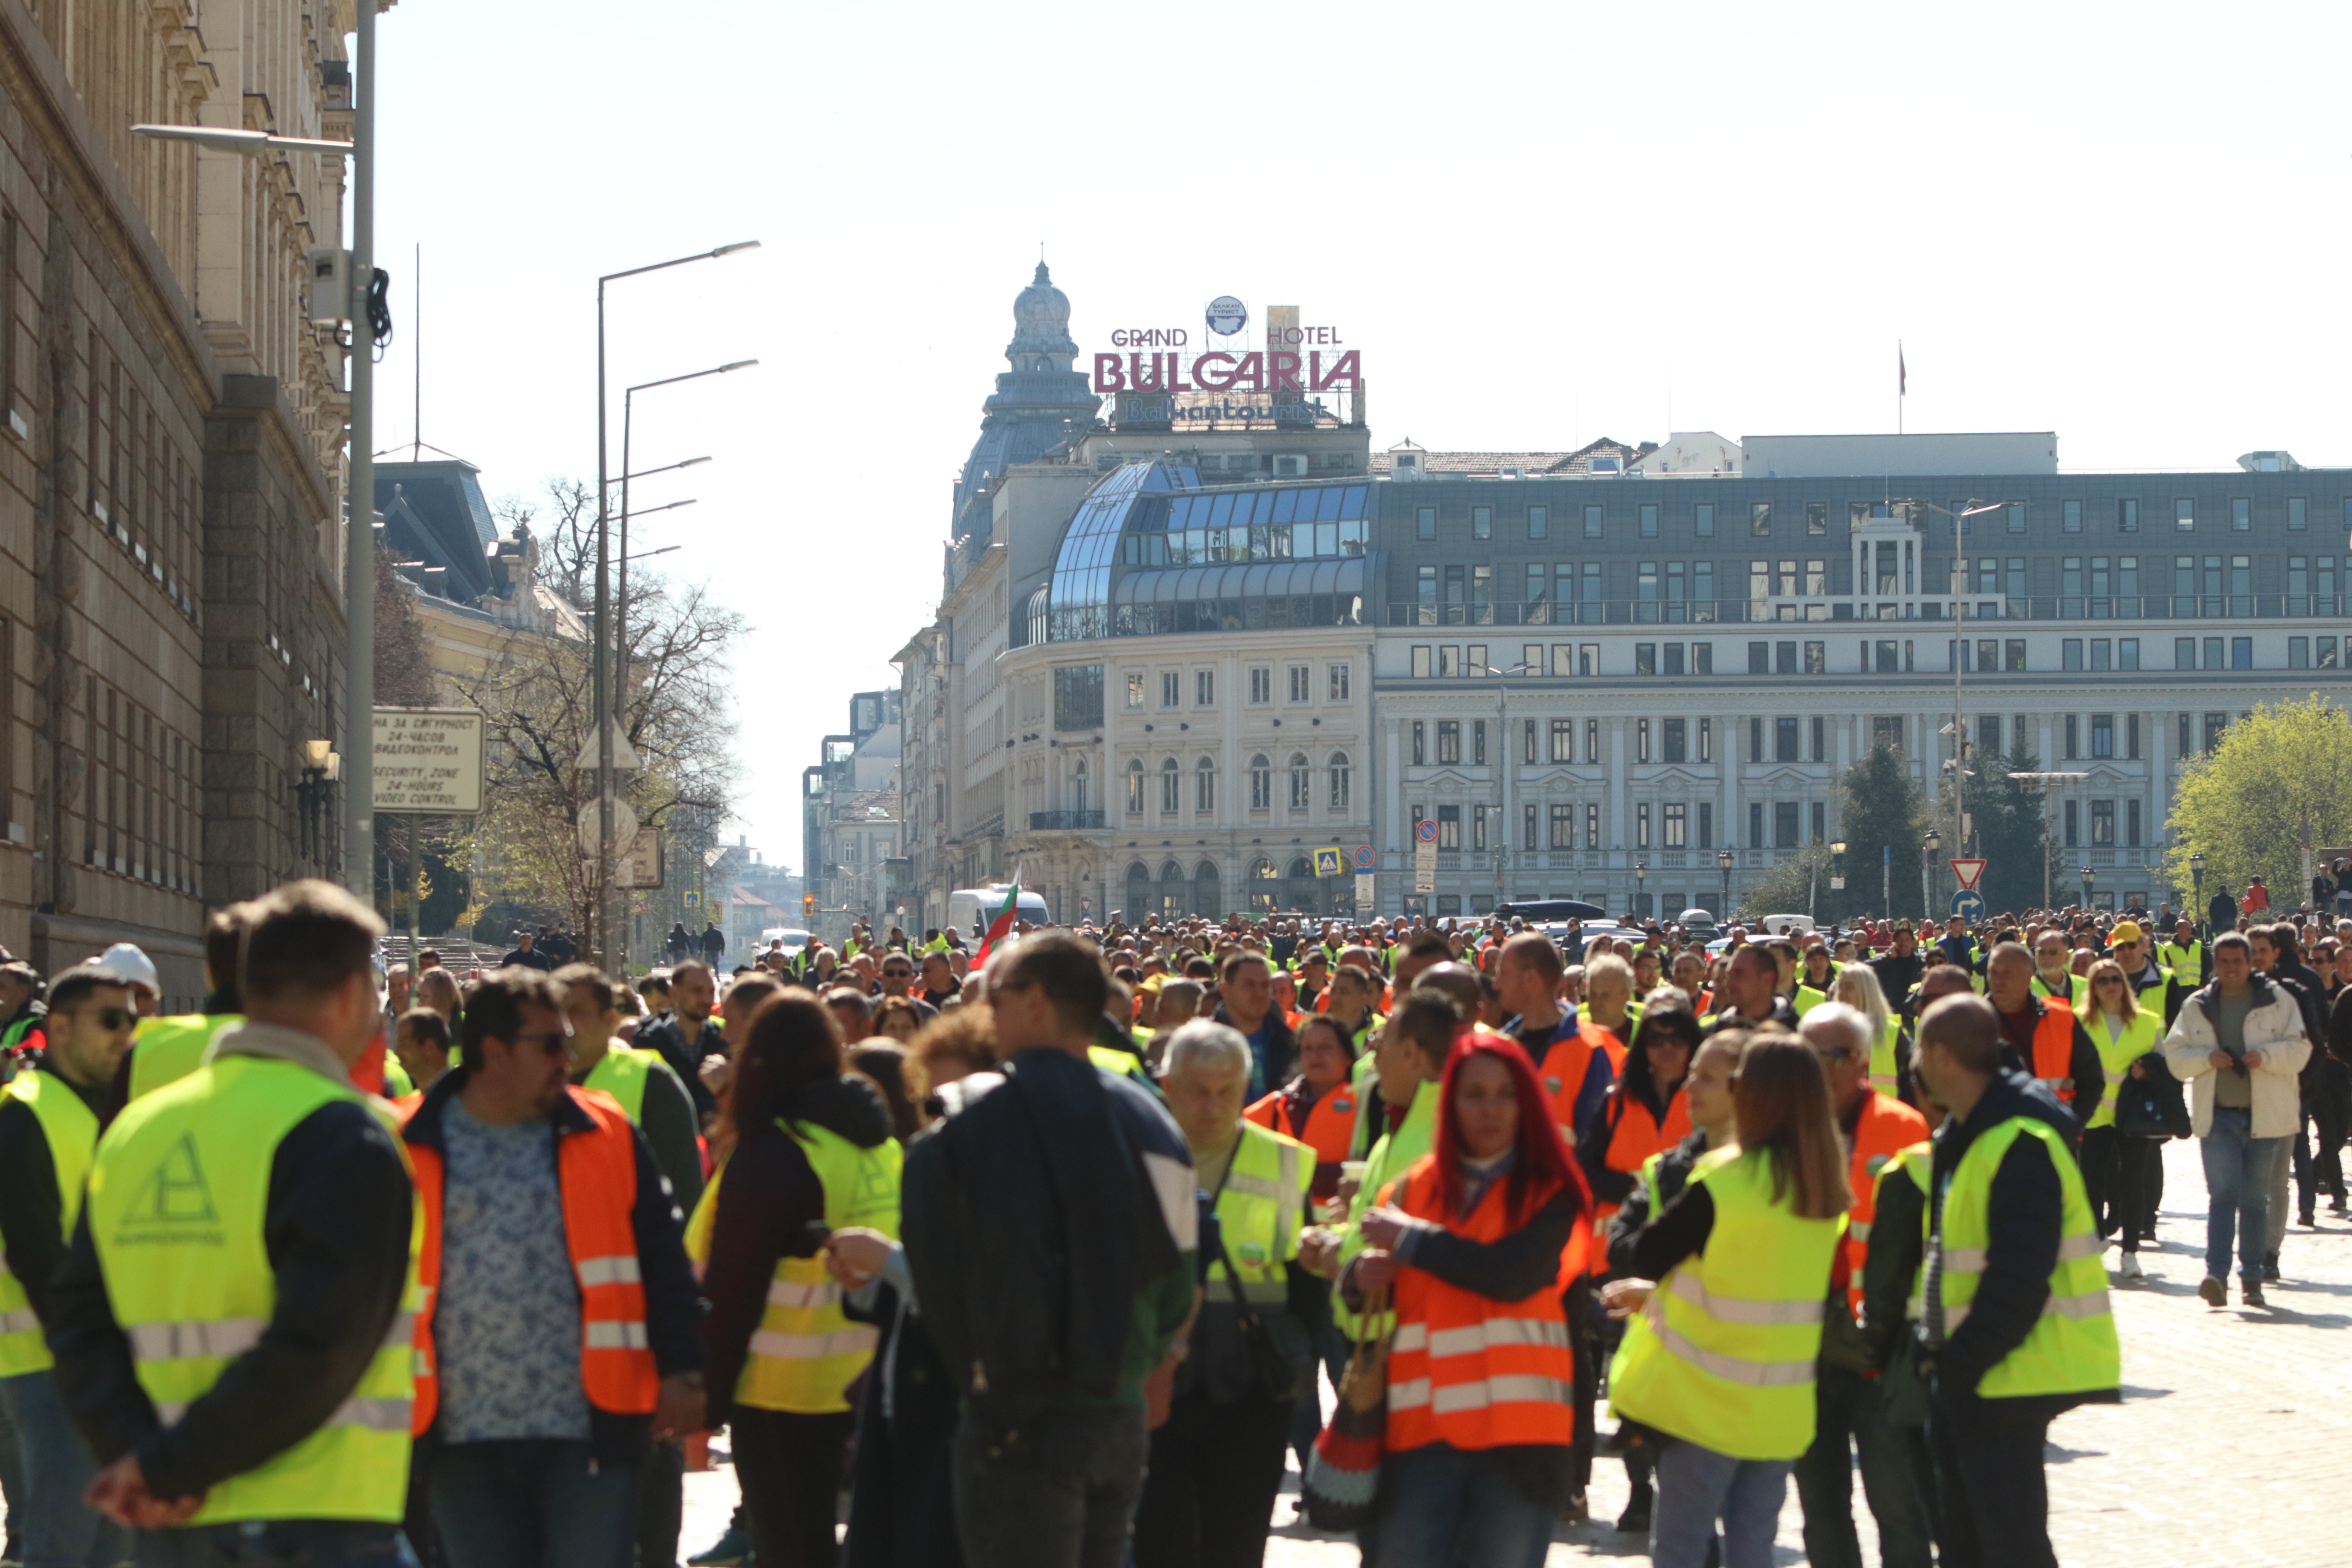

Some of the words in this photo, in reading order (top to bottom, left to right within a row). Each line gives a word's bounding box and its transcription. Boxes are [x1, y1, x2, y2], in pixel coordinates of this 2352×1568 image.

[1111, 329, 1188, 346] GRAND
[1267, 326, 1342, 344] HOTEL
[1094, 350, 1361, 393] BULGARIA
[1126, 397, 1327, 424] Balkantourist
[373, 718, 387, 727] НА
[413, 719, 474, 730] СИГУРНОСТ
[373, 766, 424, 778] SECURITY
[431, 768, 460, 778] ZONE
[374, 793, 406, 803] VIDEO
[410, 794, 456, 805] CONTROL
